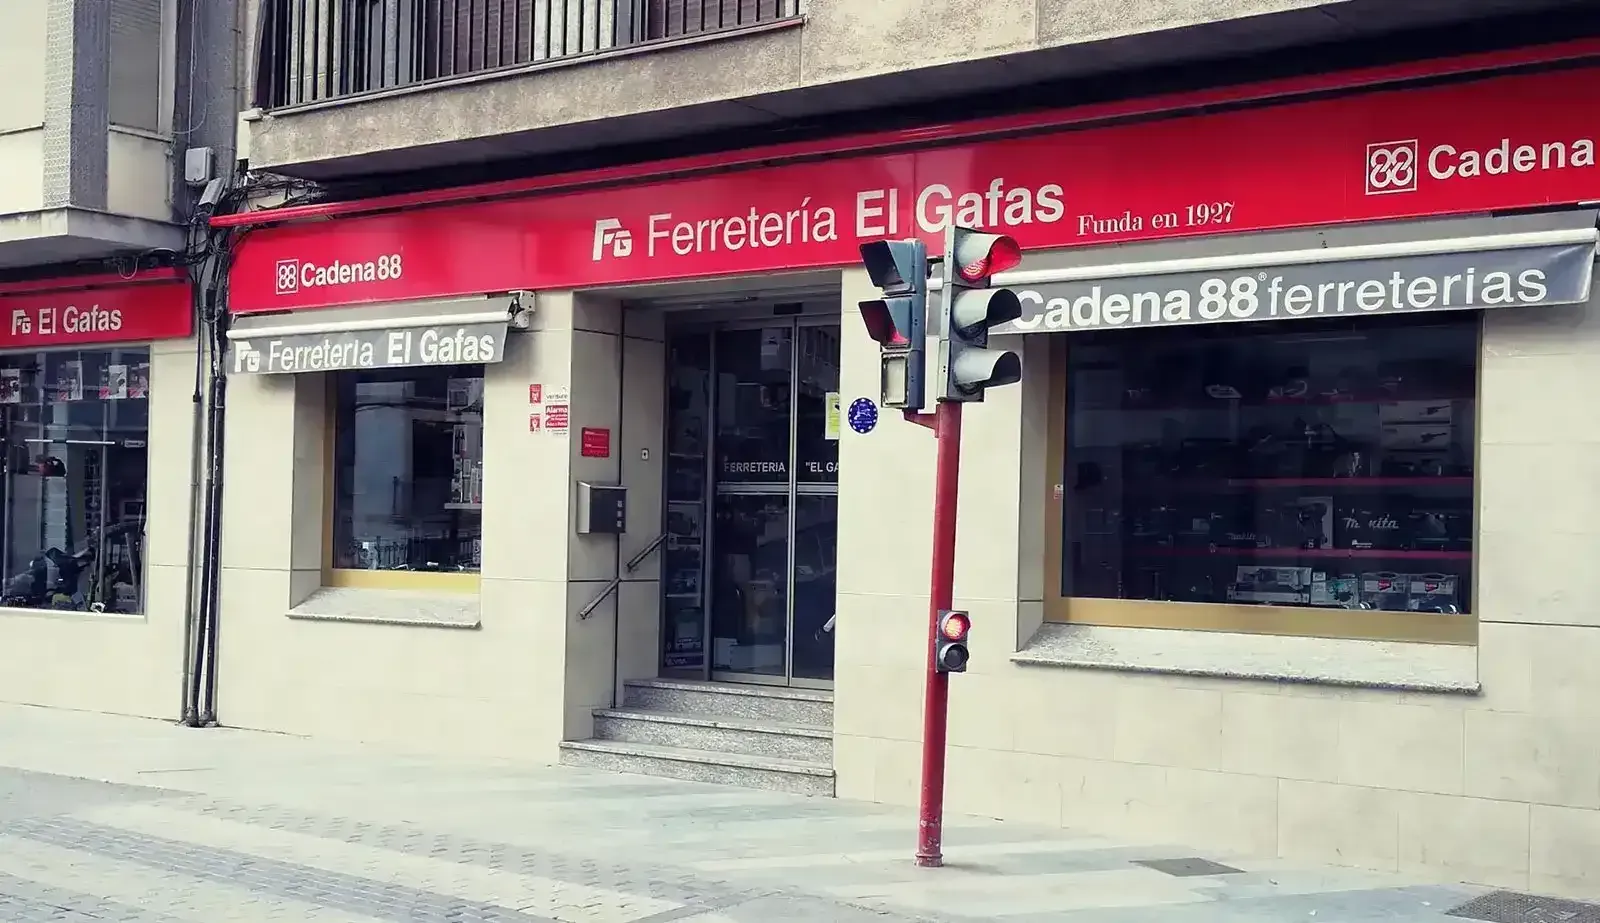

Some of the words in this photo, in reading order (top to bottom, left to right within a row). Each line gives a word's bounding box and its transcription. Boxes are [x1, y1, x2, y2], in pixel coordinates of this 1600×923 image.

[1427, 138, 1595, 180] Cadena
[648, 196, 838, 258] Ferretería
[856, 188, 898, 238] El
[915, 178, 1065, 234] Gafas
[1076, 210, 1143, 237] Funda
[1151, 212, 1180, 230] en
[1184, 201, 1236, 228] 1927
[1010, 286, 1191, 330] Cadena
[1267, 267, 1548, 317] ferreterias
[38, 307, 57, 334] El
[62, 304, 122, 334] Gafas
[387, 331, 413, 364] El
[419, 328, 495, 363] Gafas
[724, 462, 786, 473] FERRETERIA
